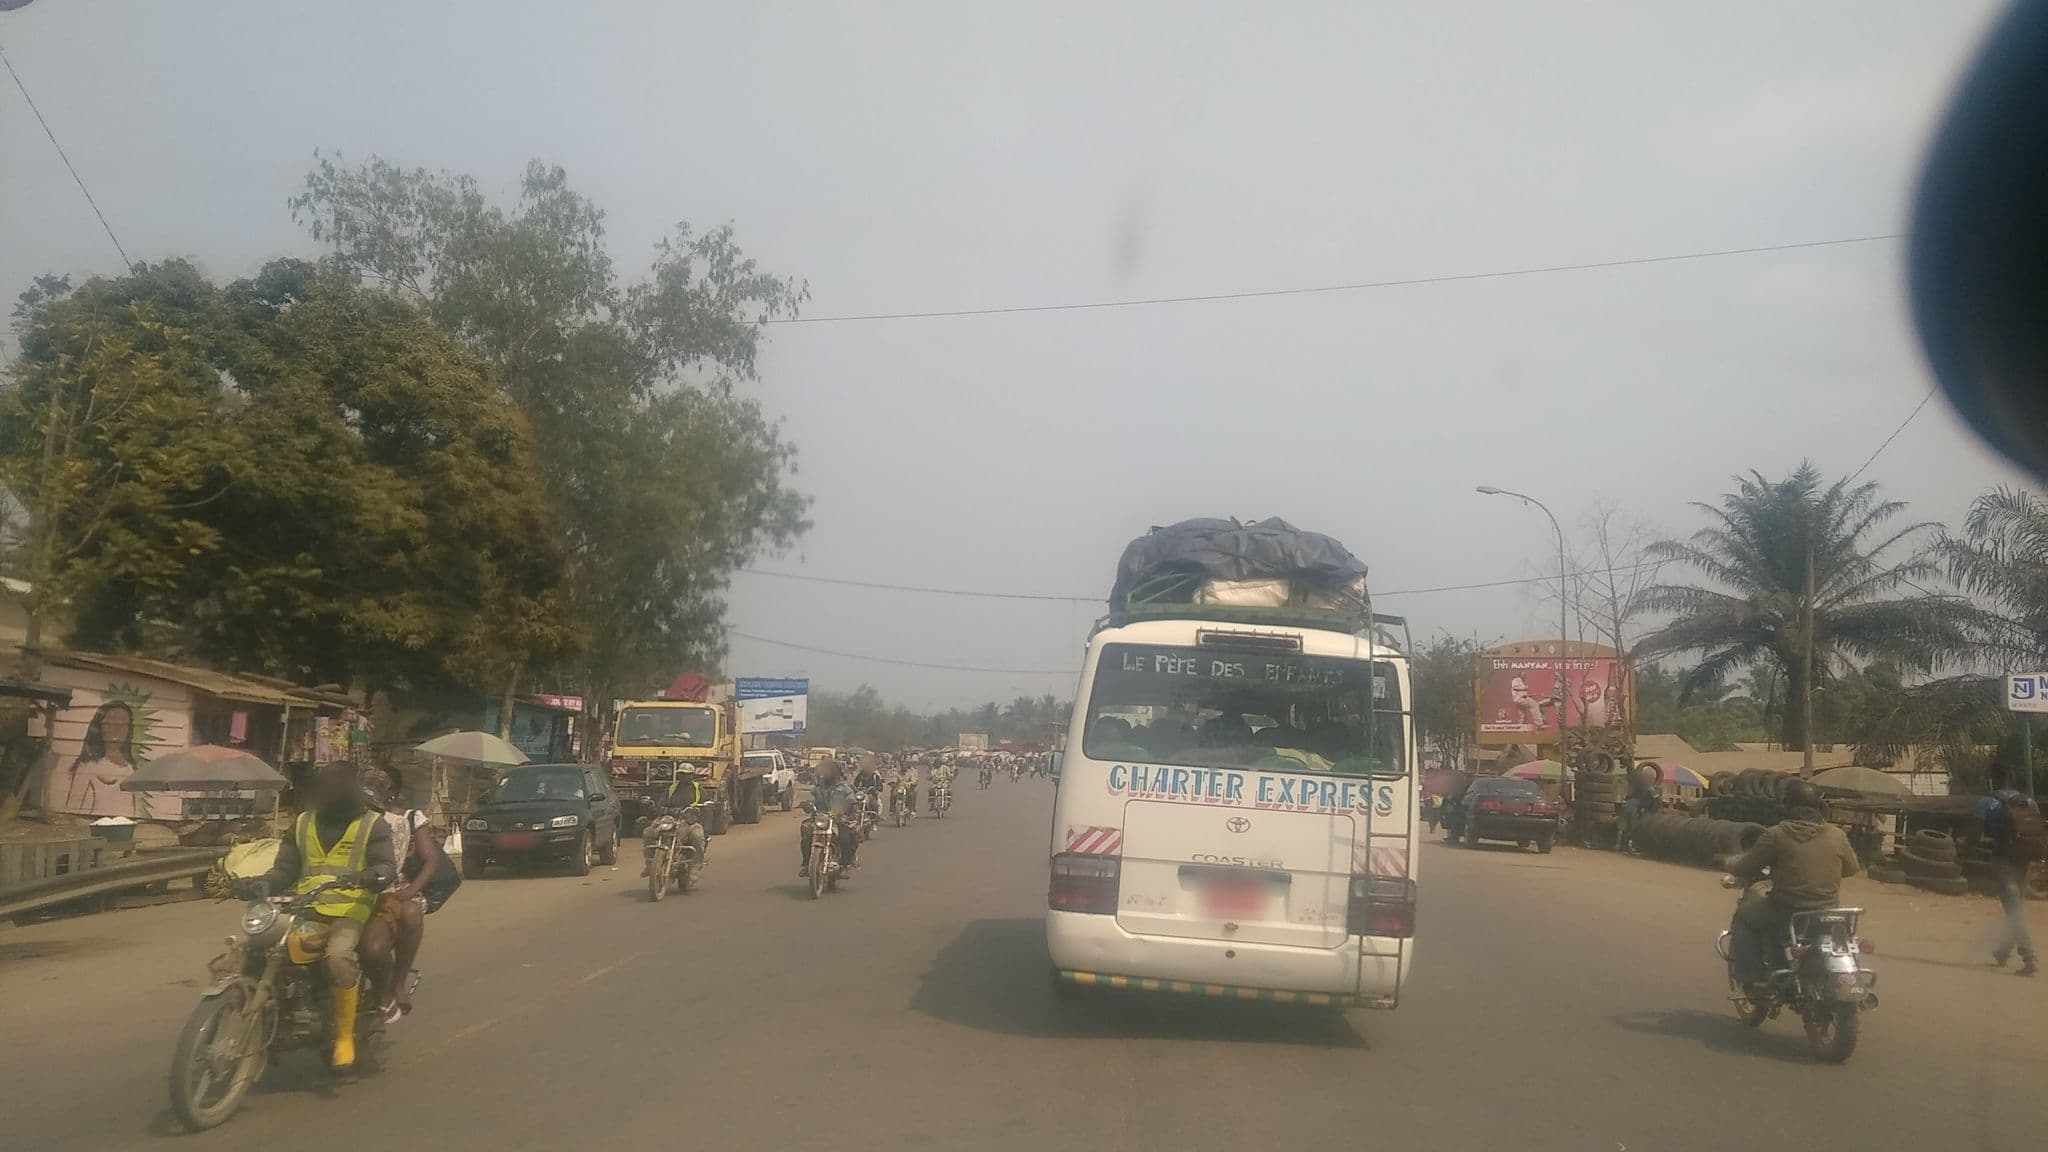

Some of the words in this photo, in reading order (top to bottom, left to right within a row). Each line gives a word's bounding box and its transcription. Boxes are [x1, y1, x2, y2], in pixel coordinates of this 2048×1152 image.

[1122, 652, 1145, 672] LE
[1211, 660, 1245, 678] DES
[1109, 765, 1244, 804] CHARTER
[1256, 775, 1394, 816] EXPRESS
[1192, 853, 1284, 869] COASTER
